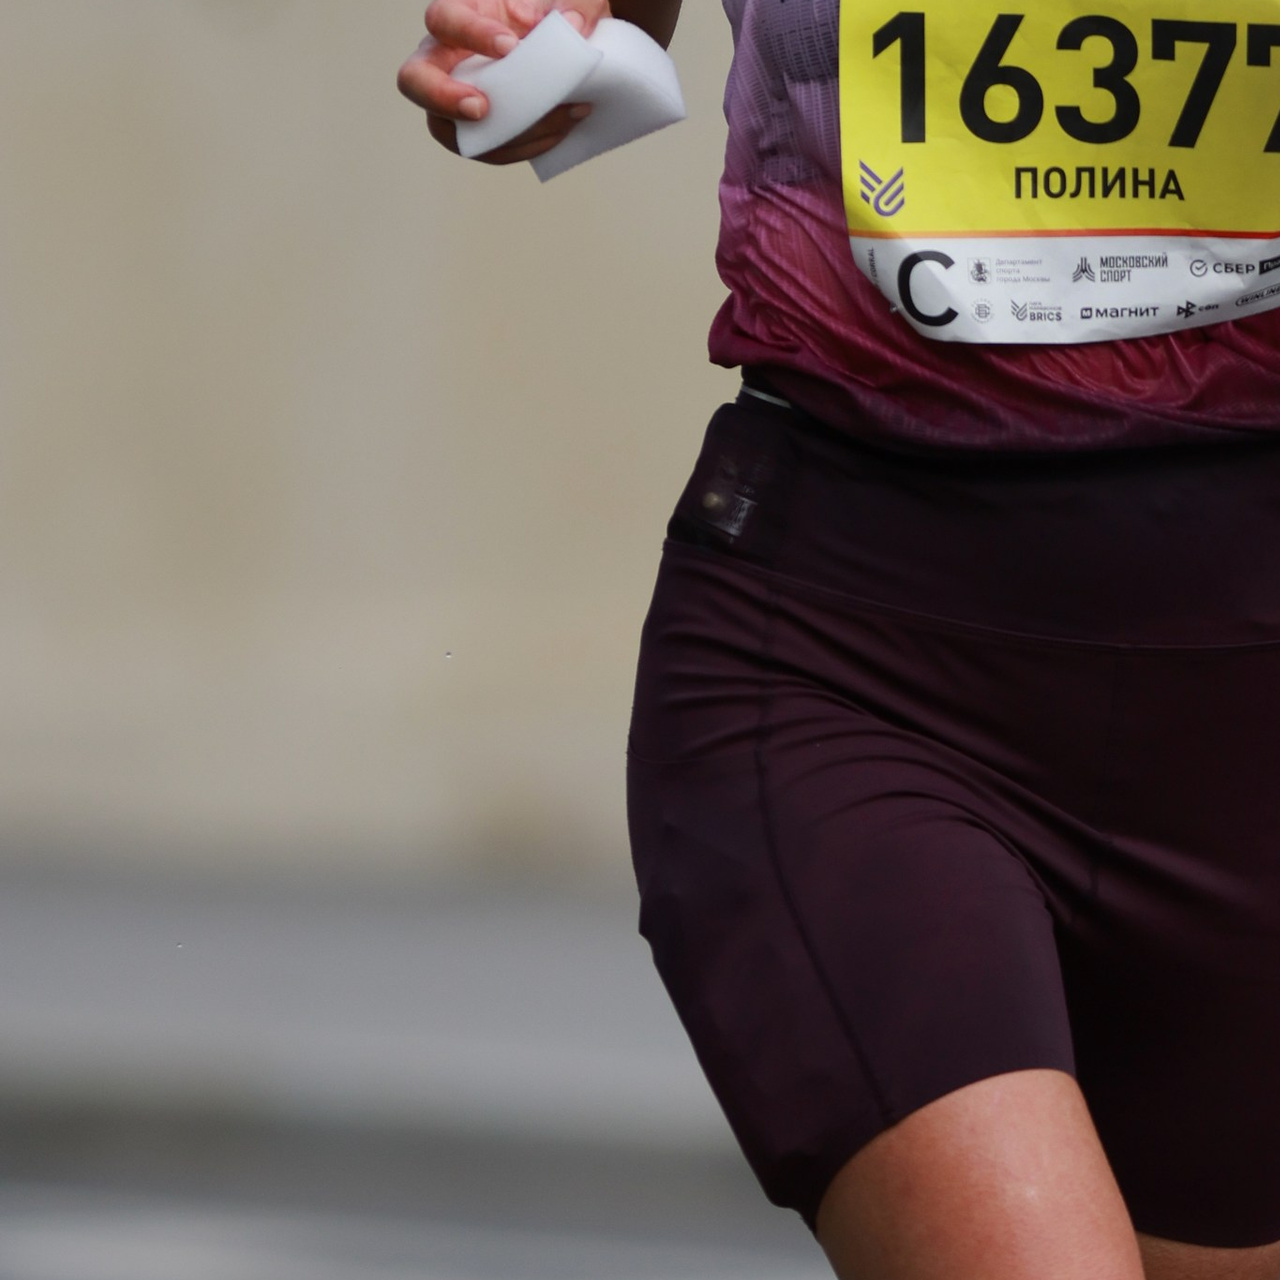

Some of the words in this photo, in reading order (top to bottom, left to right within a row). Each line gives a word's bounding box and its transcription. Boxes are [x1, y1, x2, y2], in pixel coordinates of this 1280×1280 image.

[1013, 165, 1186, 202] ПОЛИНА
[1100, 252, 1169, 269] МОСКОВСКИЙ
[1212, 262, 1255, 275] СБЕР
[1100, 269, 1132, 283] СПОРТ
[1029, 311, 1062, 322] BRICS
